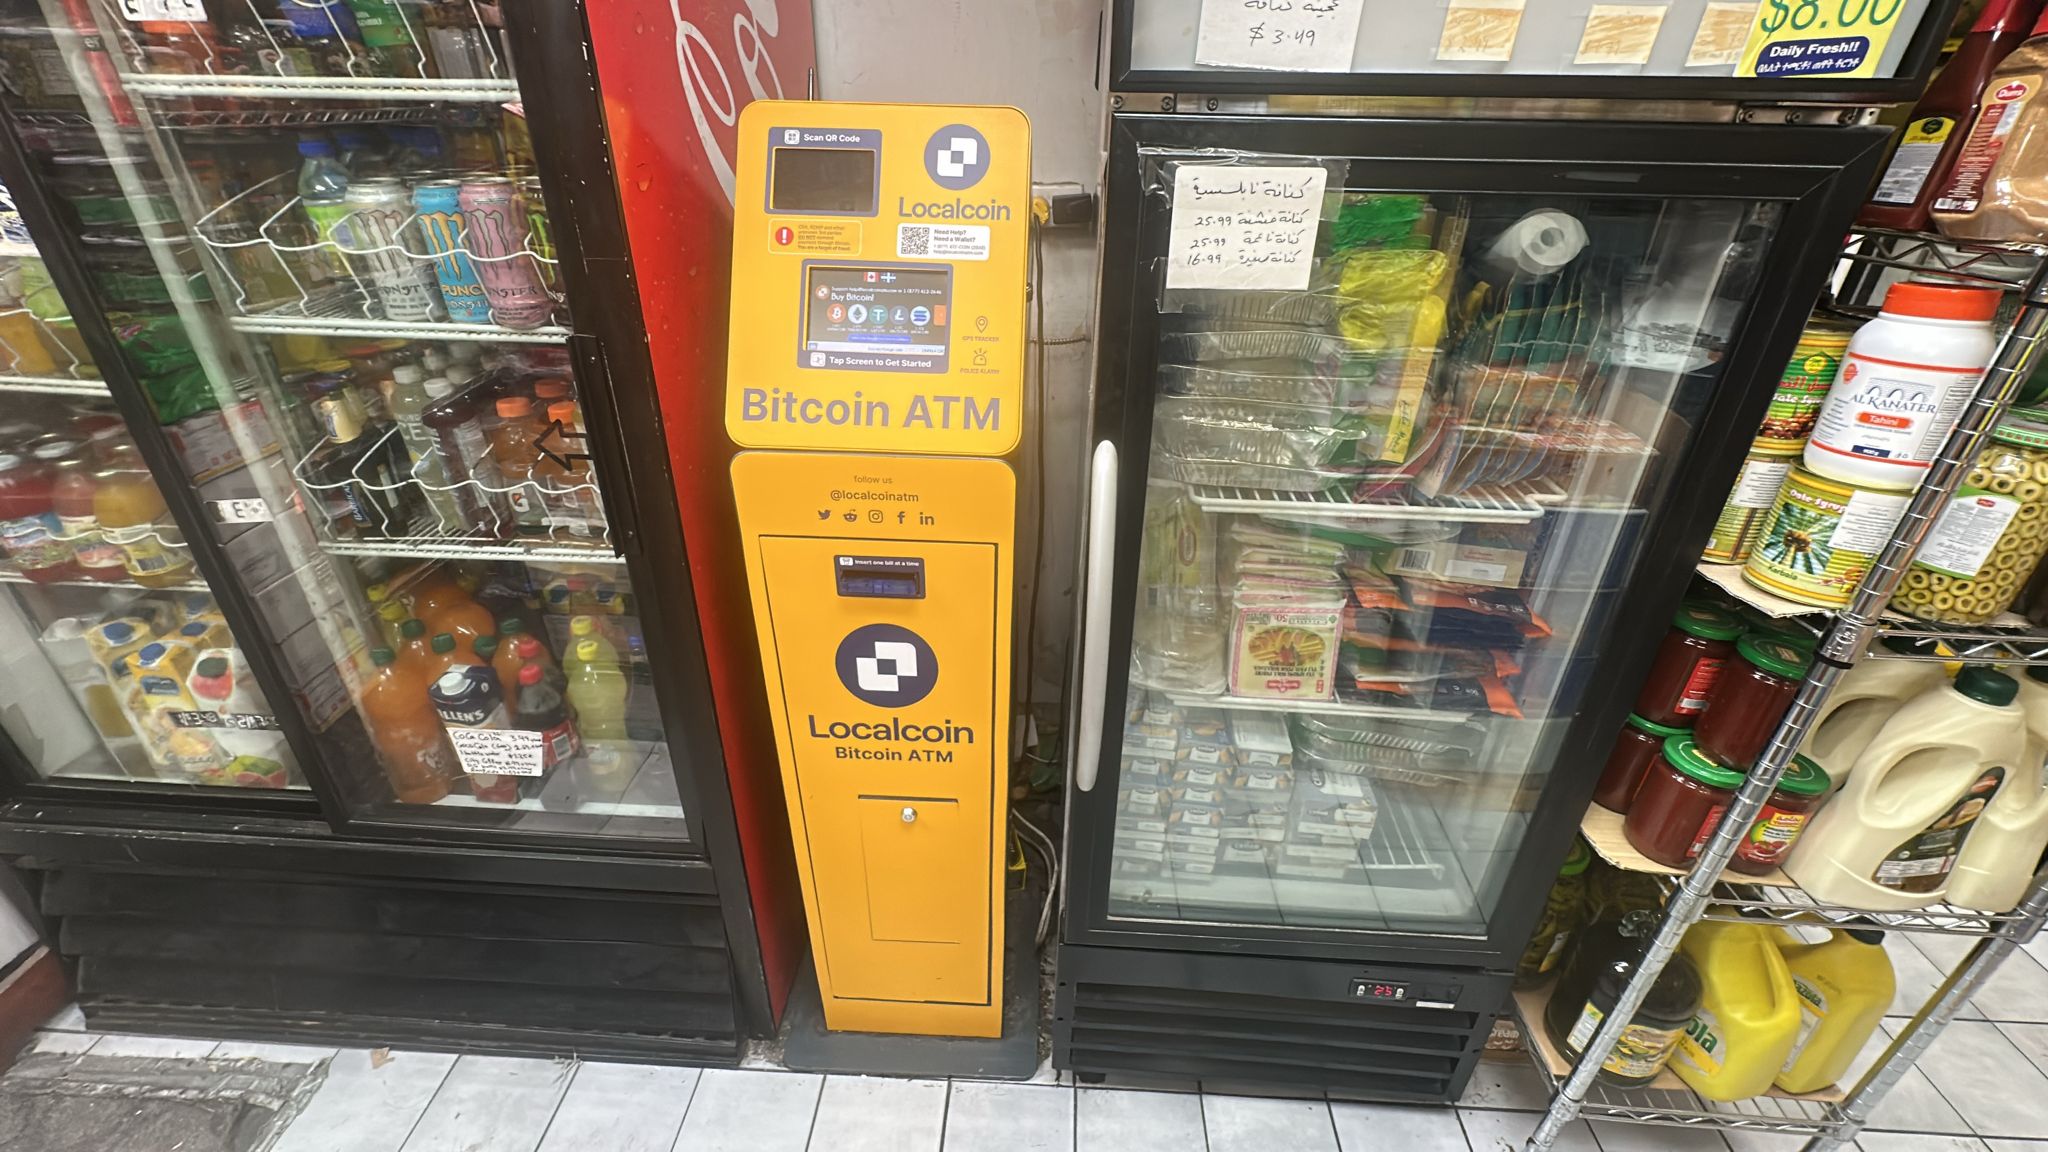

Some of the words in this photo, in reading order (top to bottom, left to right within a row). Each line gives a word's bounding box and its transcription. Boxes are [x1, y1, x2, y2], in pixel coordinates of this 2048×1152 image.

[1272, 29, 1316, 46] 3.49
[1769, 46, 1805, 58] Daily
[1806, 41, 1861, 55] Fresh!!
[804, 133, 824, 141] Scan
[825, 133, 838, 142] QR
[839, 134, 860, 143] Code
[898, 196, 1011, 221] Localcoin
[1194, 216, 1232, 226] 25.99
[1190, 237, 1226, 249] 25.99
[1187, 254, 1222, 265] 16.99
[441, 284, 482, 296] PUNC
[831, 293, 845, 302] Buy
[846, 292, 874, 302] Bitcoin!
[829, 356, 844, 365] Tap
[846, 357, 875, 365] Screen
[875, 357, 884, 365] to
[885, 358, 900, 366] Get
[901, 359, 932, 368] Started
[741, 387, 891, 428] Bitcoin
[902, 394, 1001, 431] ATM
[1869, 415, 1900, 426] Tahini
[853, 475, 881, 485] follow
[883, 476, 893, 485] us
[829, 489, 919, 503] @localcoinatm
[808, 714, 974, 744] Localcoin
[835, 746, 902, 761] Bitcoin
[908, 749, 953, 763] ATM
